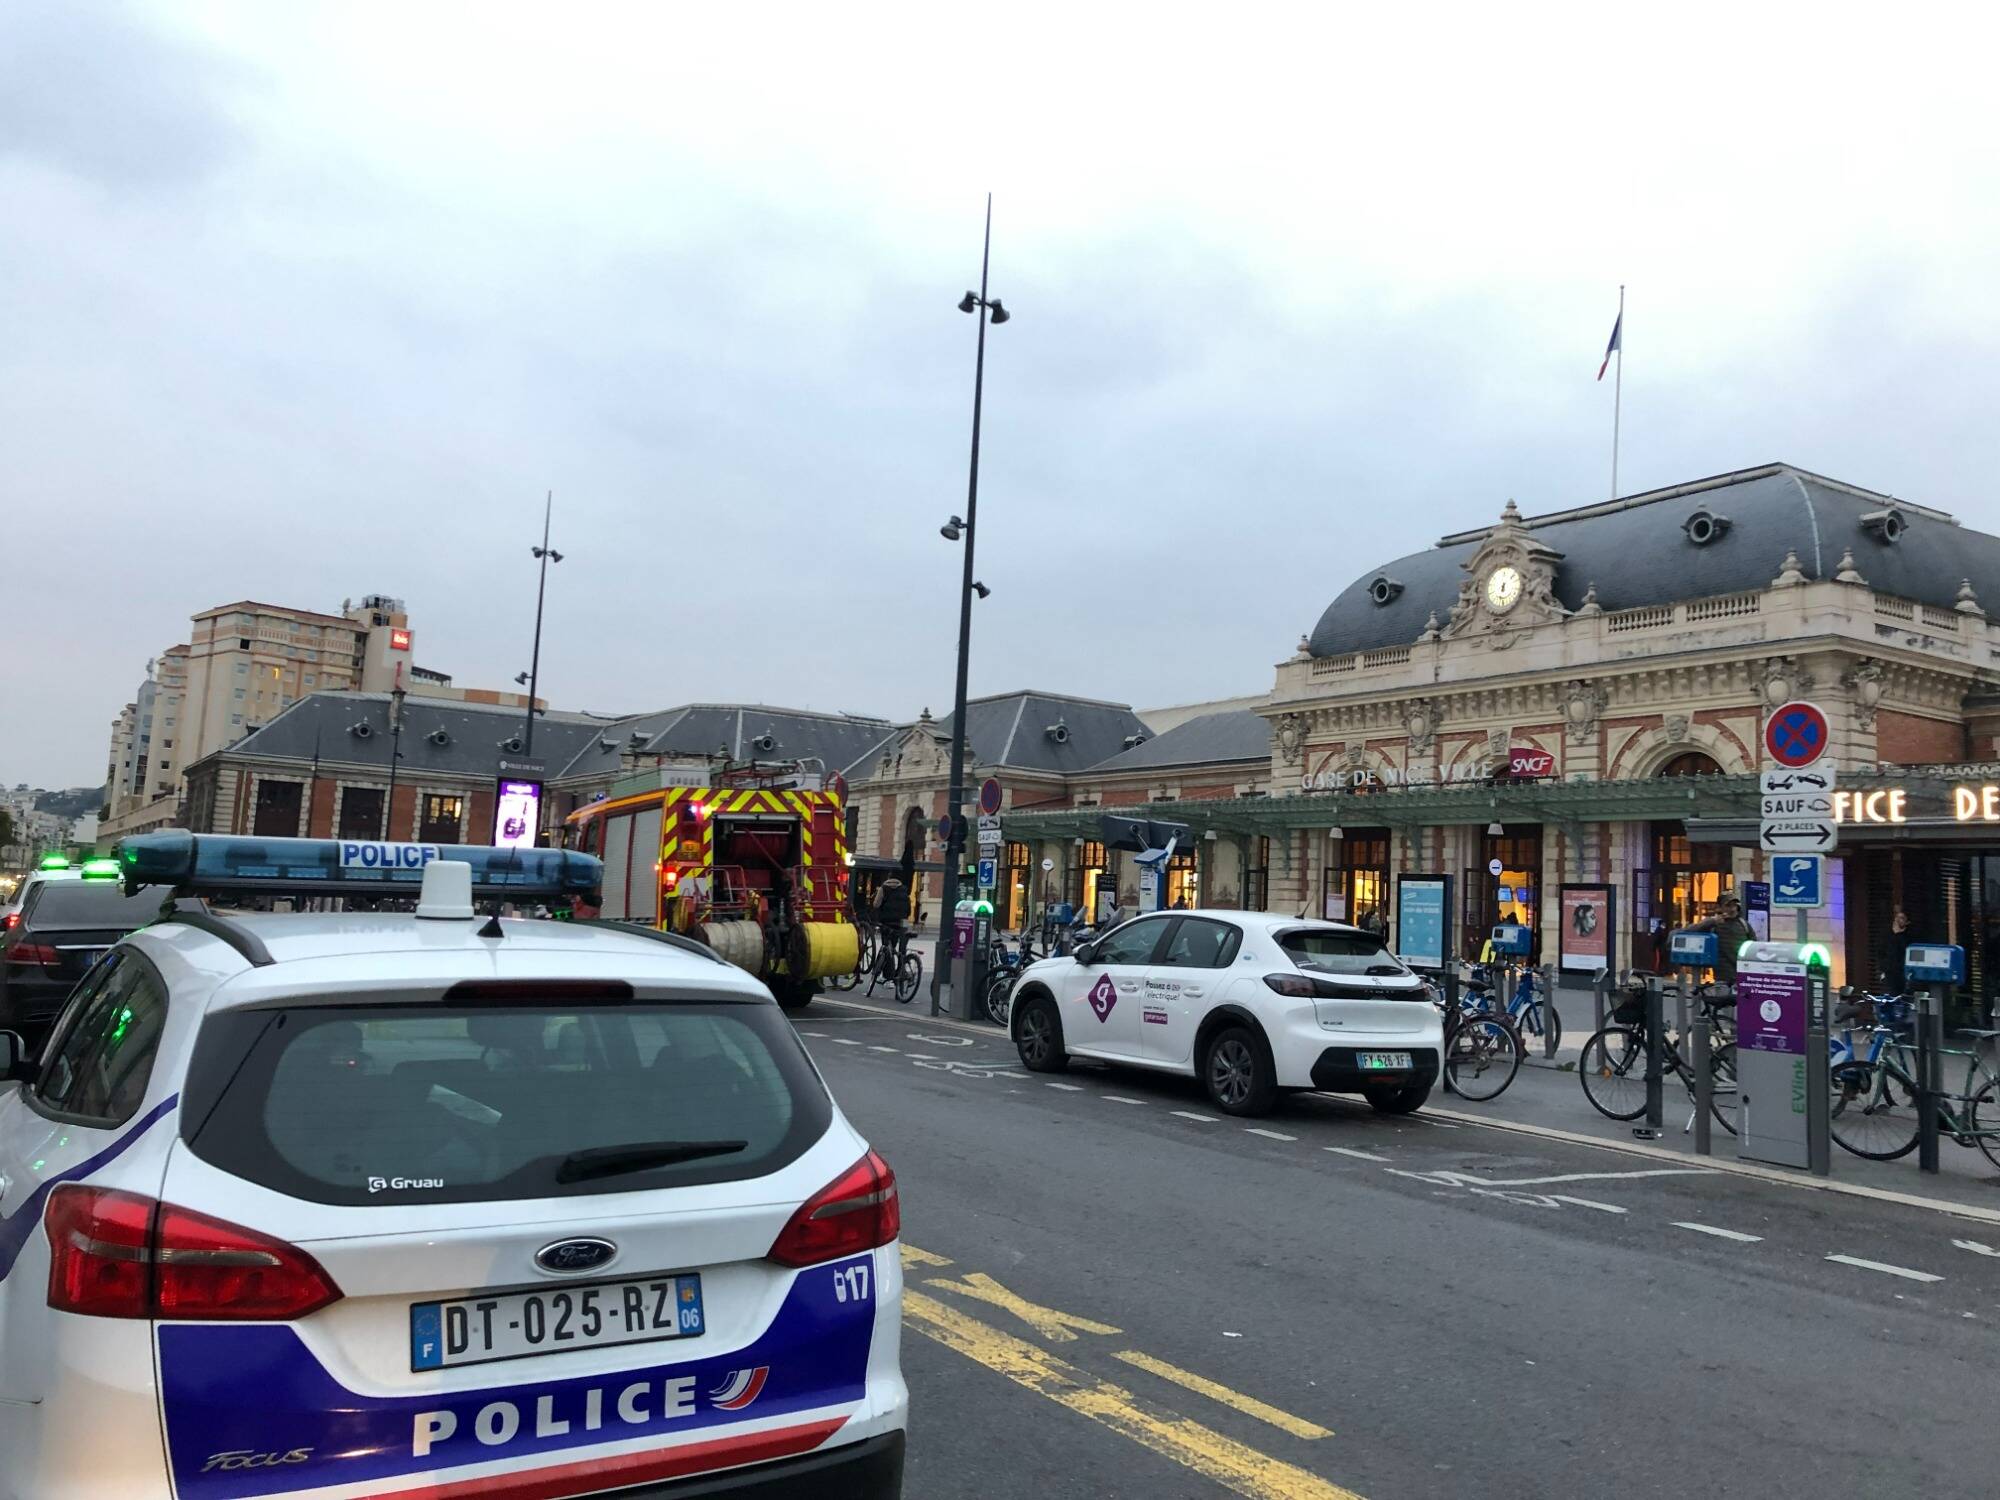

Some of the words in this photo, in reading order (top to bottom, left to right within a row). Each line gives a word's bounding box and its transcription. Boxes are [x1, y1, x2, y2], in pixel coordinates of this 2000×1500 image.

[1302, 771, 1347, 790] GARE
[1353, 769, 1377, 787] DE
[1384, 765, 1431, 785] NICE
[1439, 761, 1494, 781] VILLE
[1511, 757, 1552, 773] SNCF
[1764, 800, 1805, 814] SAUF
[1955, 786, 2000, 821] DE
[1778, 823, 1783, 831] 2
[1784, 822, 1816, 831] PLACES
[343, 843, 435, 868] POLICE
[391, 1177, 444, 1189] Gruau
[422, 1342, 433, 1359] F
[446, 1282, 672, 1356] DT-025-RZ
[681, 1306, 700, 1329] 06
[411, 1375, 699, 1458] POLICE
